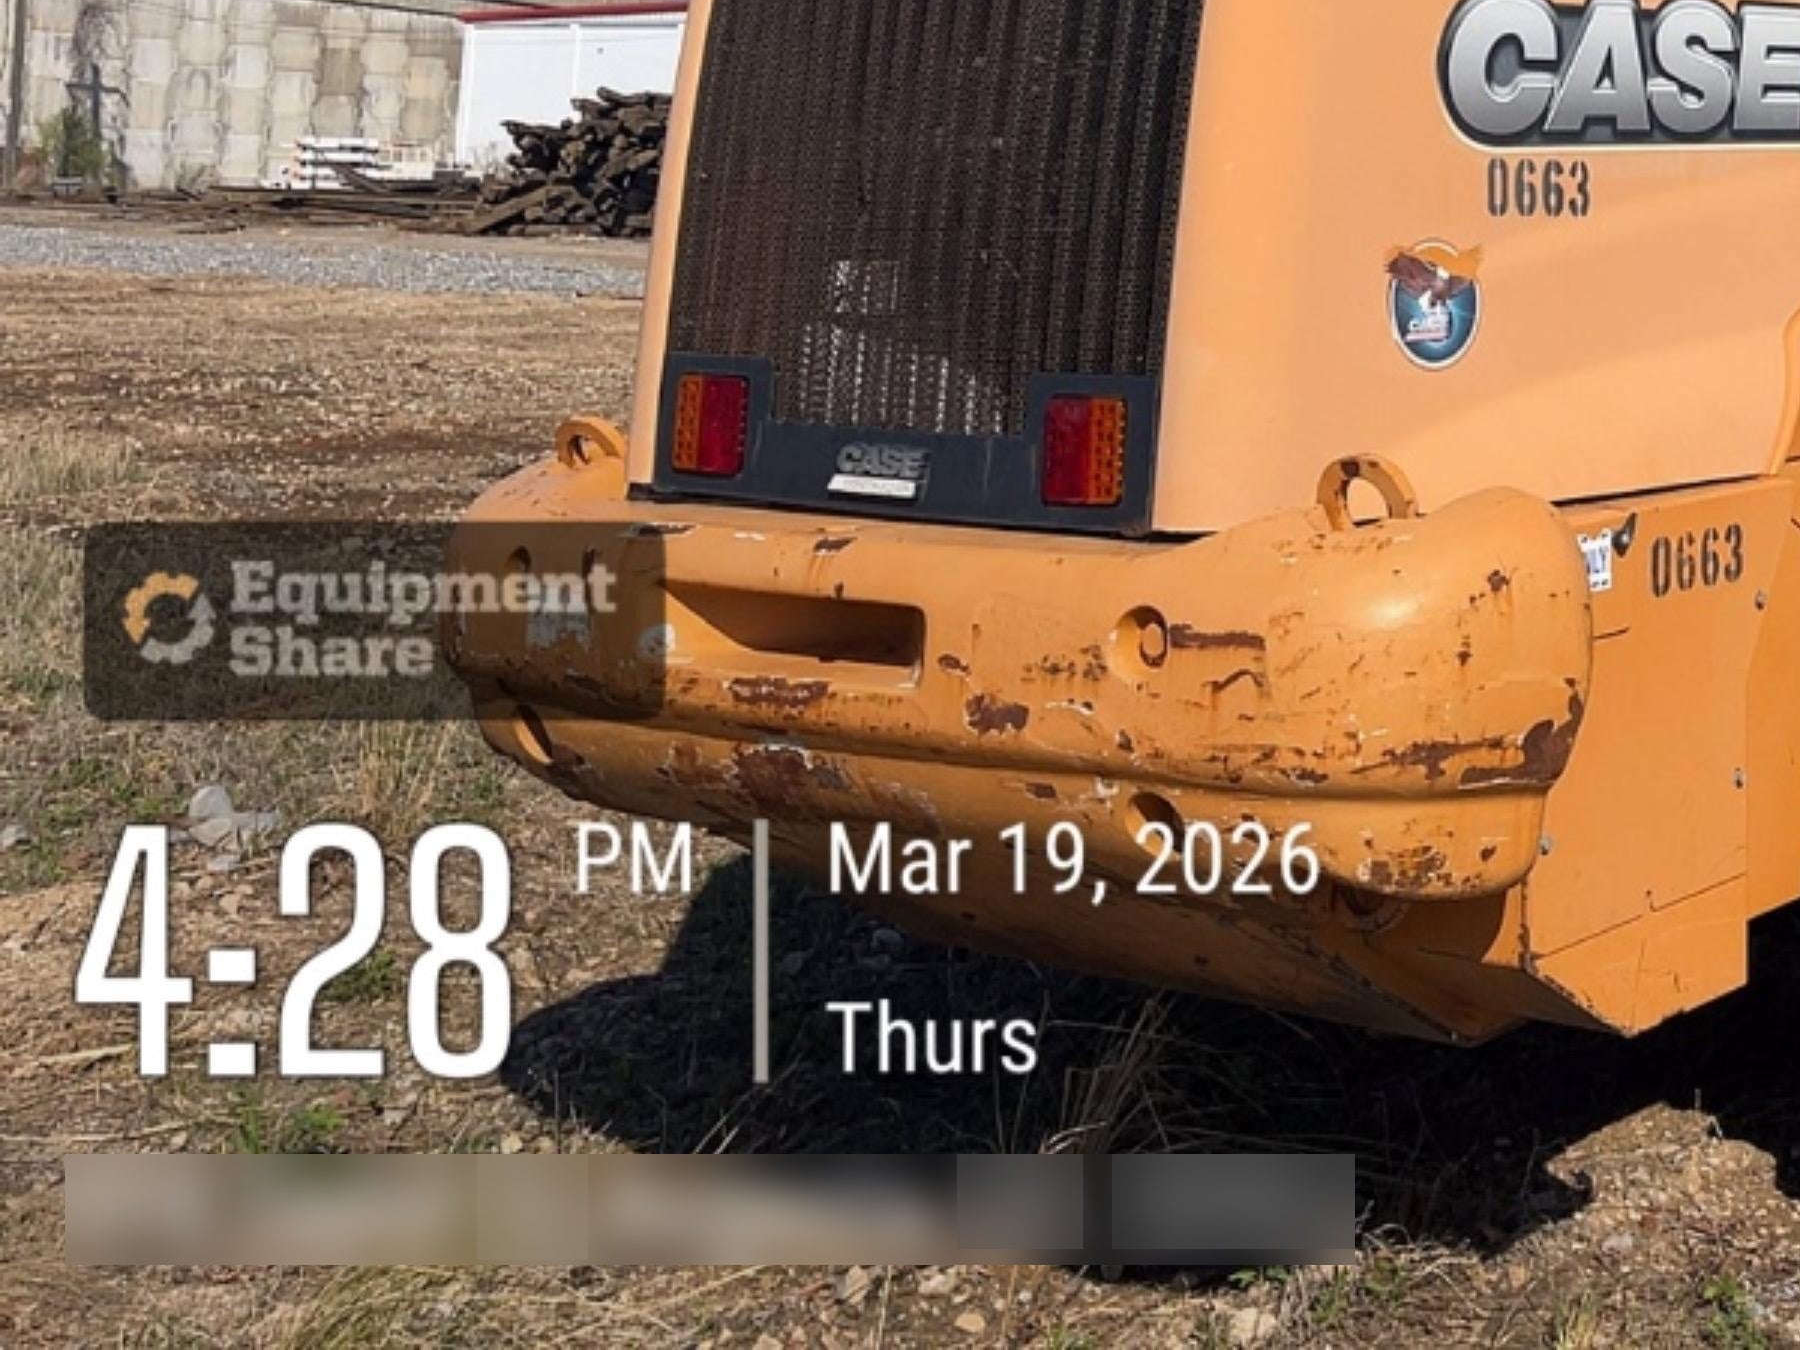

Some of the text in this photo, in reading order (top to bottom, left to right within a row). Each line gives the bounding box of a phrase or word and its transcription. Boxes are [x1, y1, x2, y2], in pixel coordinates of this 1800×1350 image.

[1487, 158, 1591, 217] 0663
[836, 441, 928, 478] CASE
[1651, 523, 1743, 598] 0663
